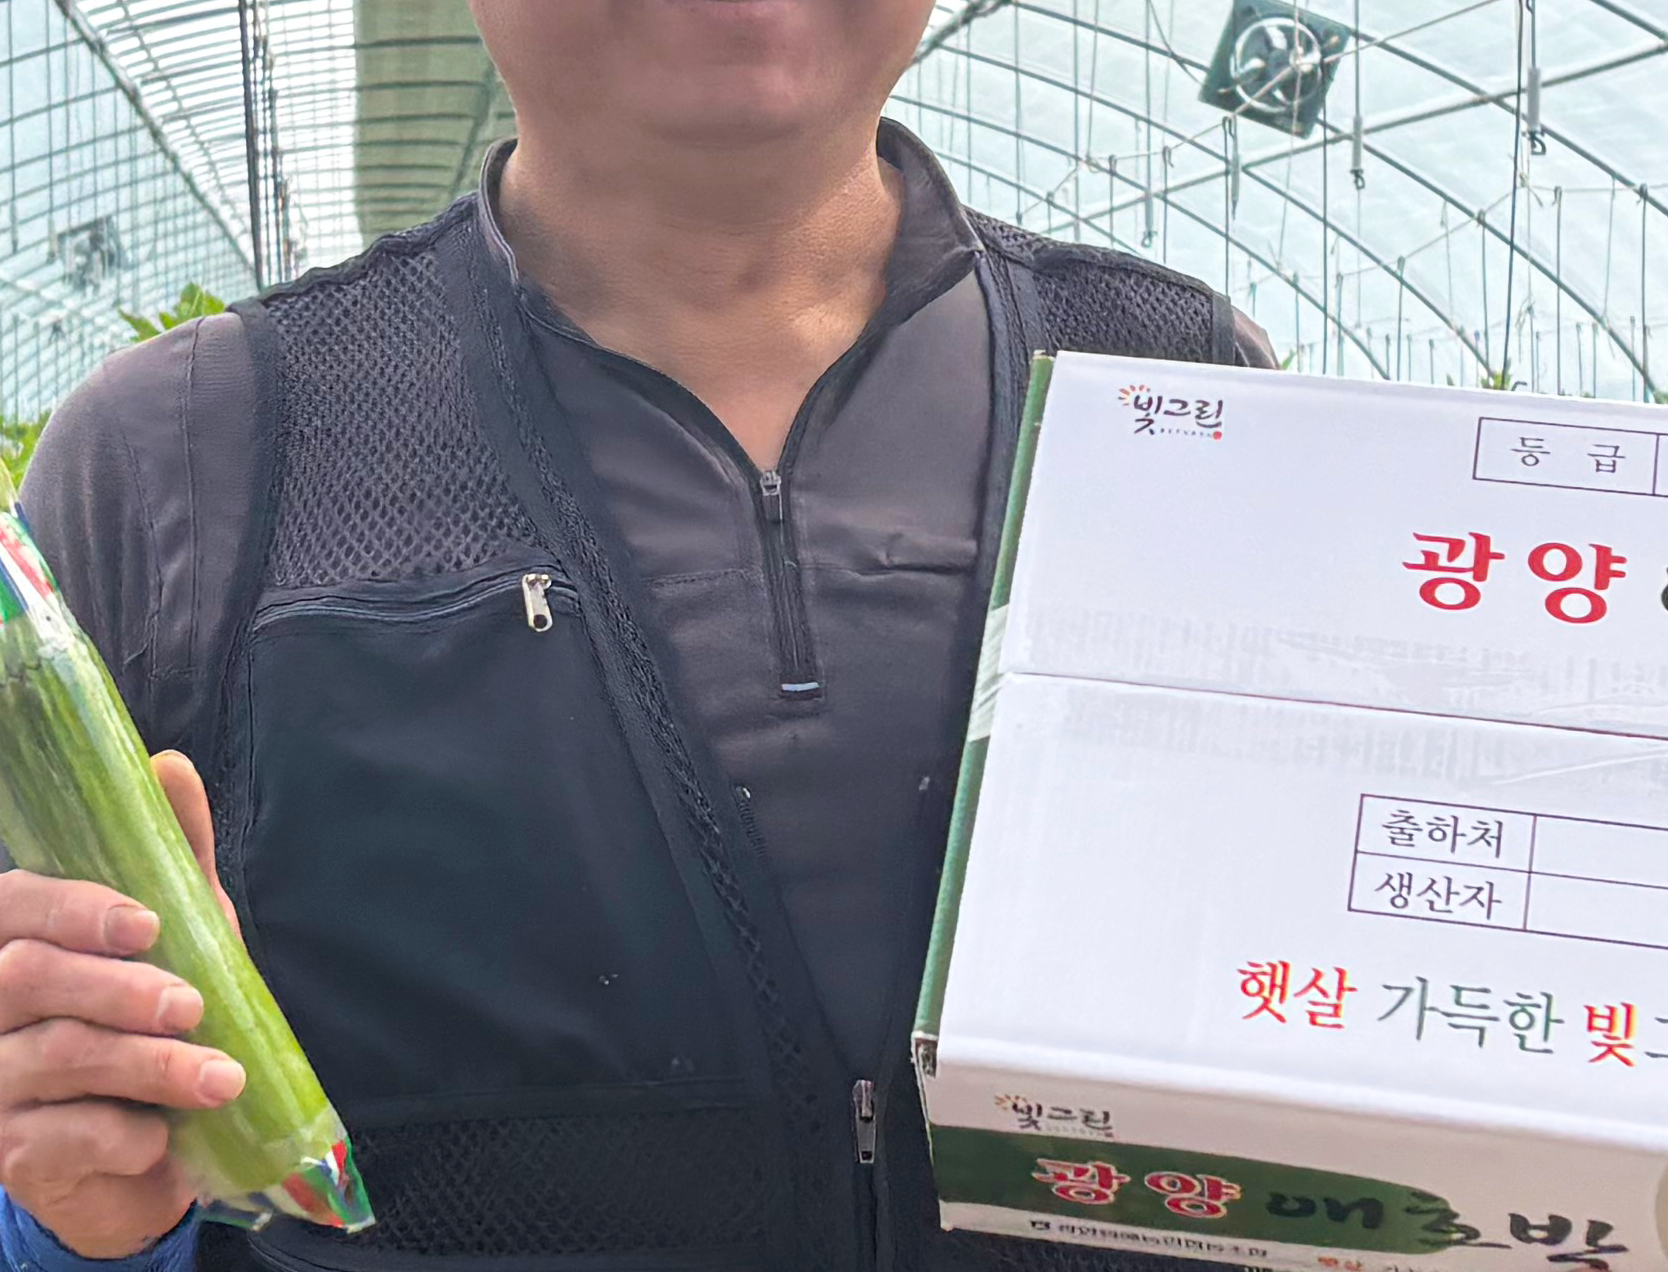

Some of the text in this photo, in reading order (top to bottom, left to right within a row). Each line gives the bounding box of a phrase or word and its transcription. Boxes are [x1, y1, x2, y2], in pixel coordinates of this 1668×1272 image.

[1132, 393, 1224, 435] 빛그린
[1401, 531, 1628, 625] 광양
[1381, 808, 1504, 859] 출하처
[1374, 871, 1503, 921] 생산자
[1236, 959, 1358, 1030] 햇살
[1376, 975, 1566, 1055] 가득한
[1031, 1156, 1244, 1220] 광양
